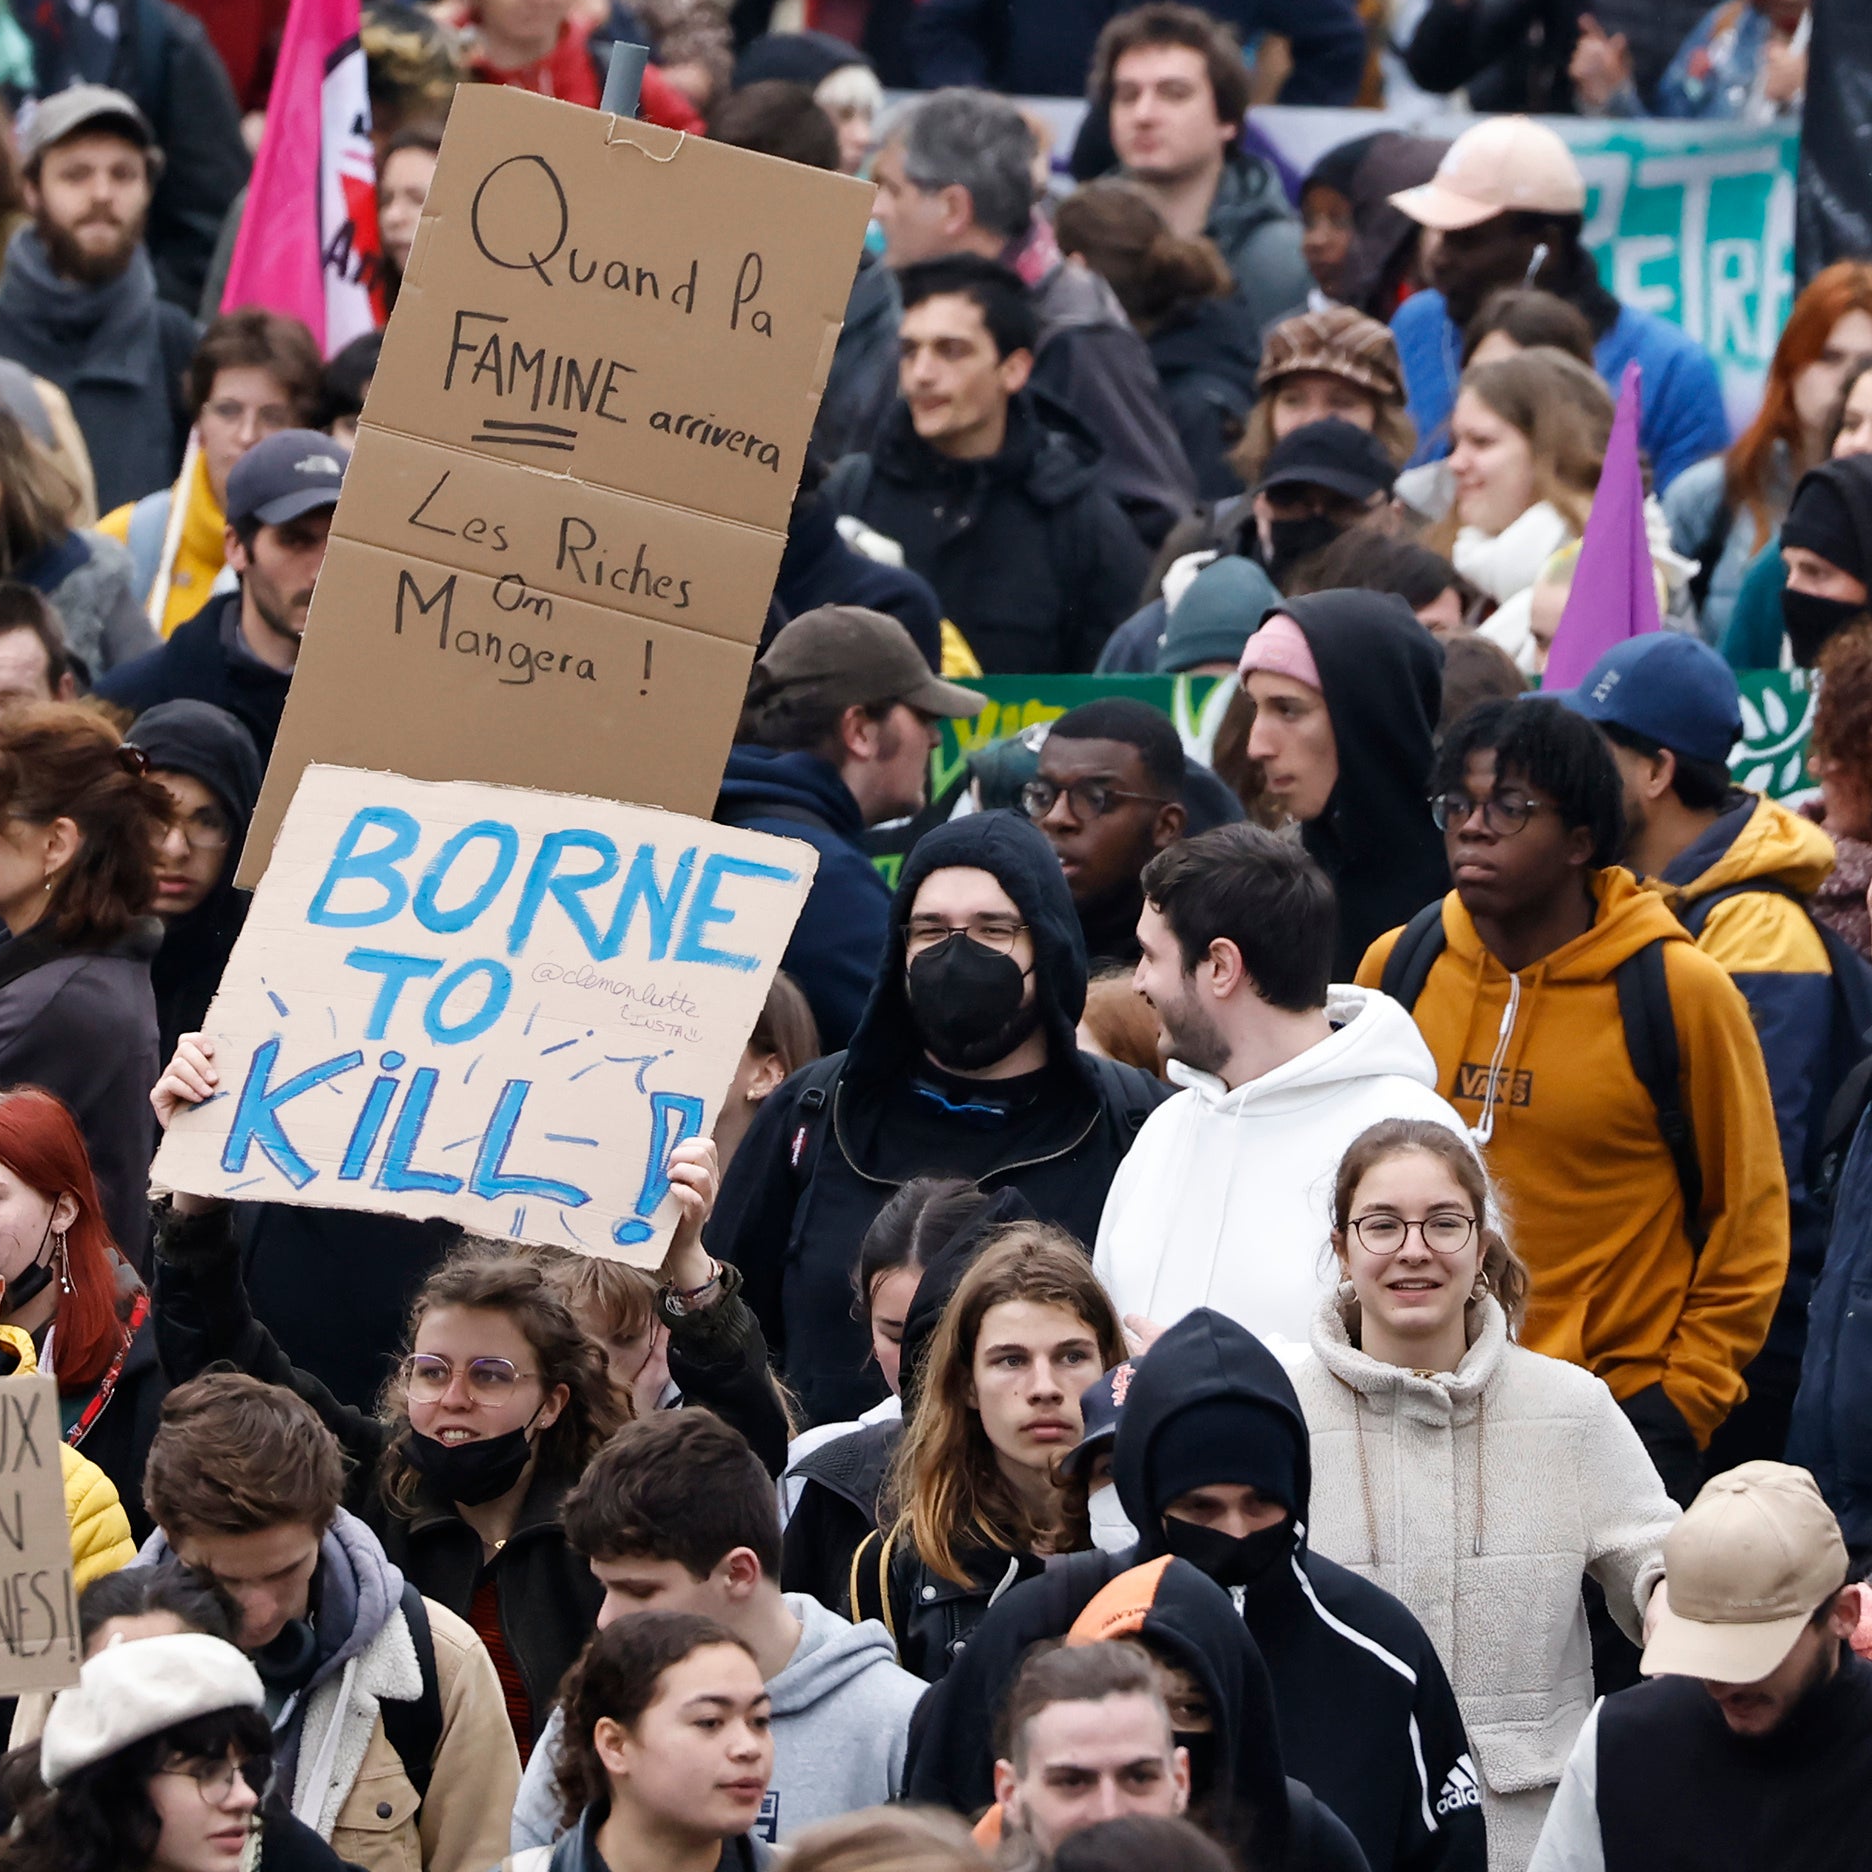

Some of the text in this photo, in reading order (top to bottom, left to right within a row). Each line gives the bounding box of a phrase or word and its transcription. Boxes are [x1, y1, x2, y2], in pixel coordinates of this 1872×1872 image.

[472, 154, 698, 315] Quand
[443, 309, 781, 474] FAMINE arrivera
[407, 469, 692, 609] Les Riches
[394, 568, 597, 685] Mangera
[305, 804, 802, 973] BORNE
[344, 946, 512, 1045] TO
